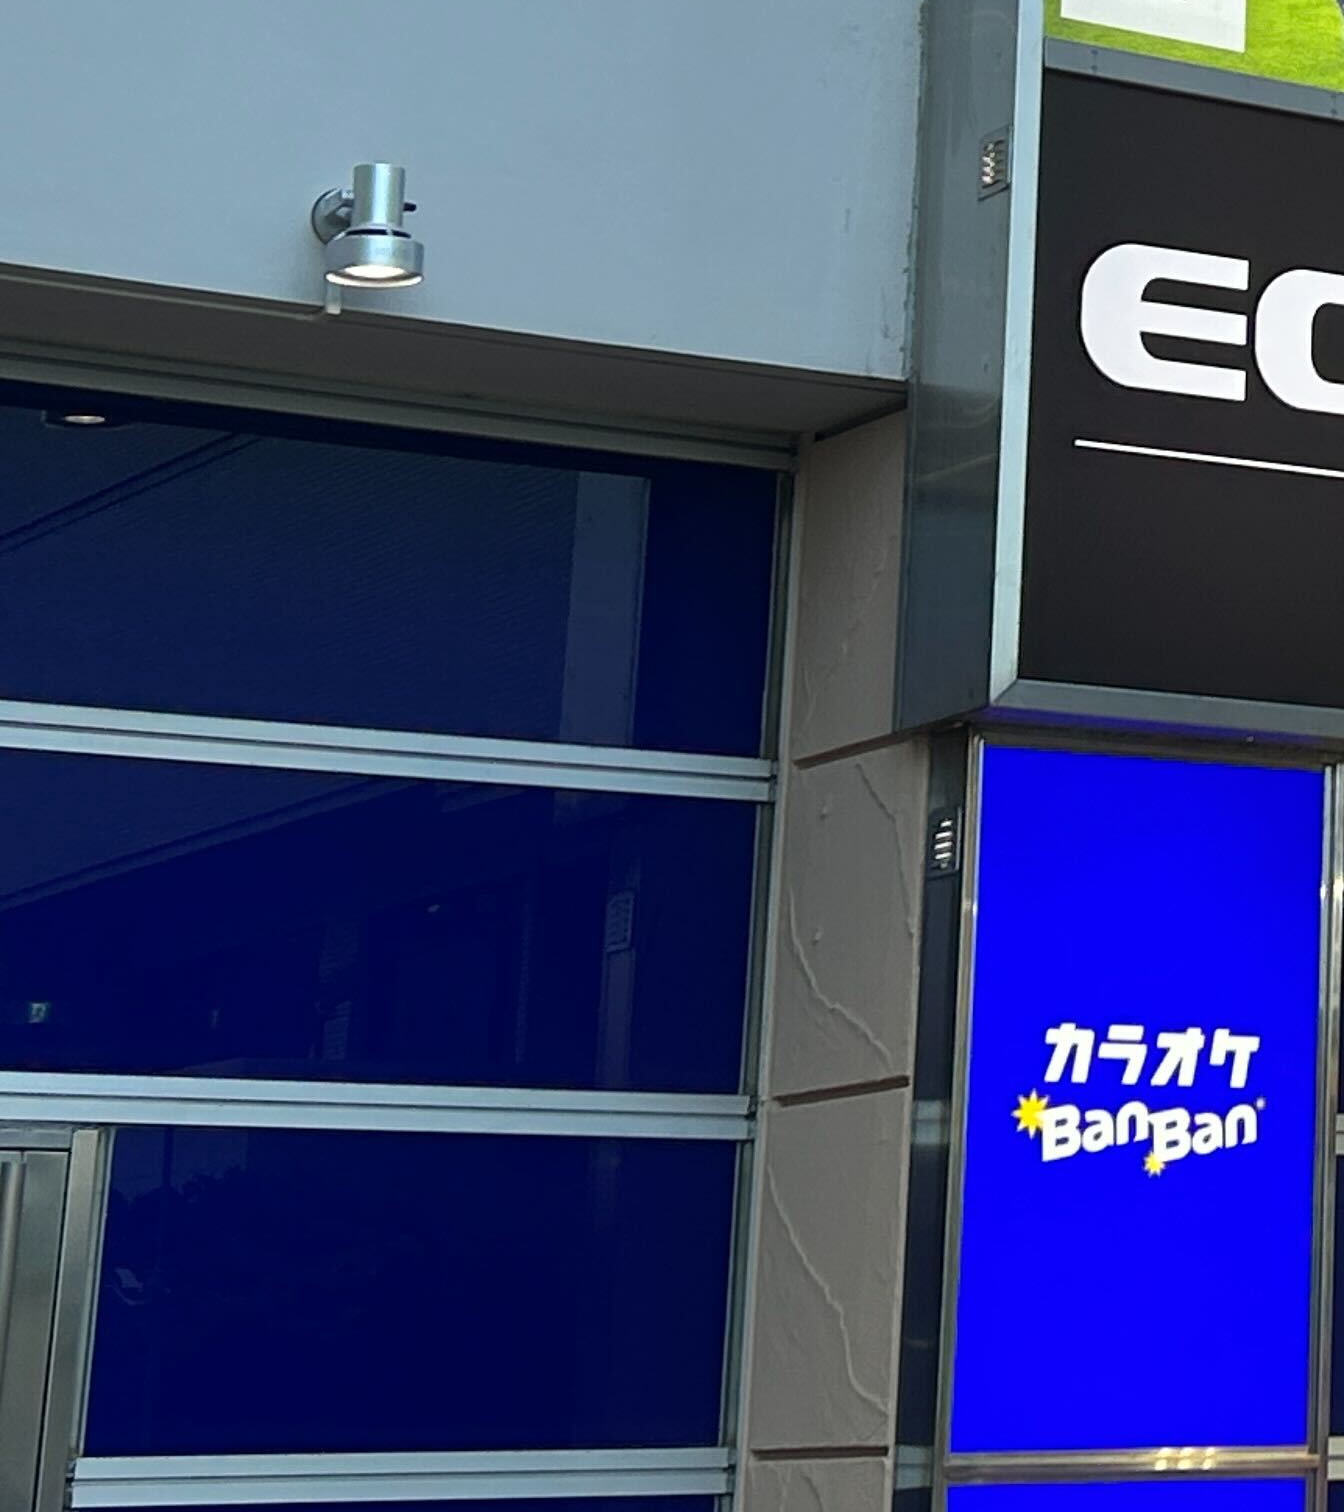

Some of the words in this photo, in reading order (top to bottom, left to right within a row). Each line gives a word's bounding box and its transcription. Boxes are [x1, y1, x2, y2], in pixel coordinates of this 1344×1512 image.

[1043, 1022, 1260, 1088] カラオケ
[1041, 1100, 1258, 1163] BanBan
